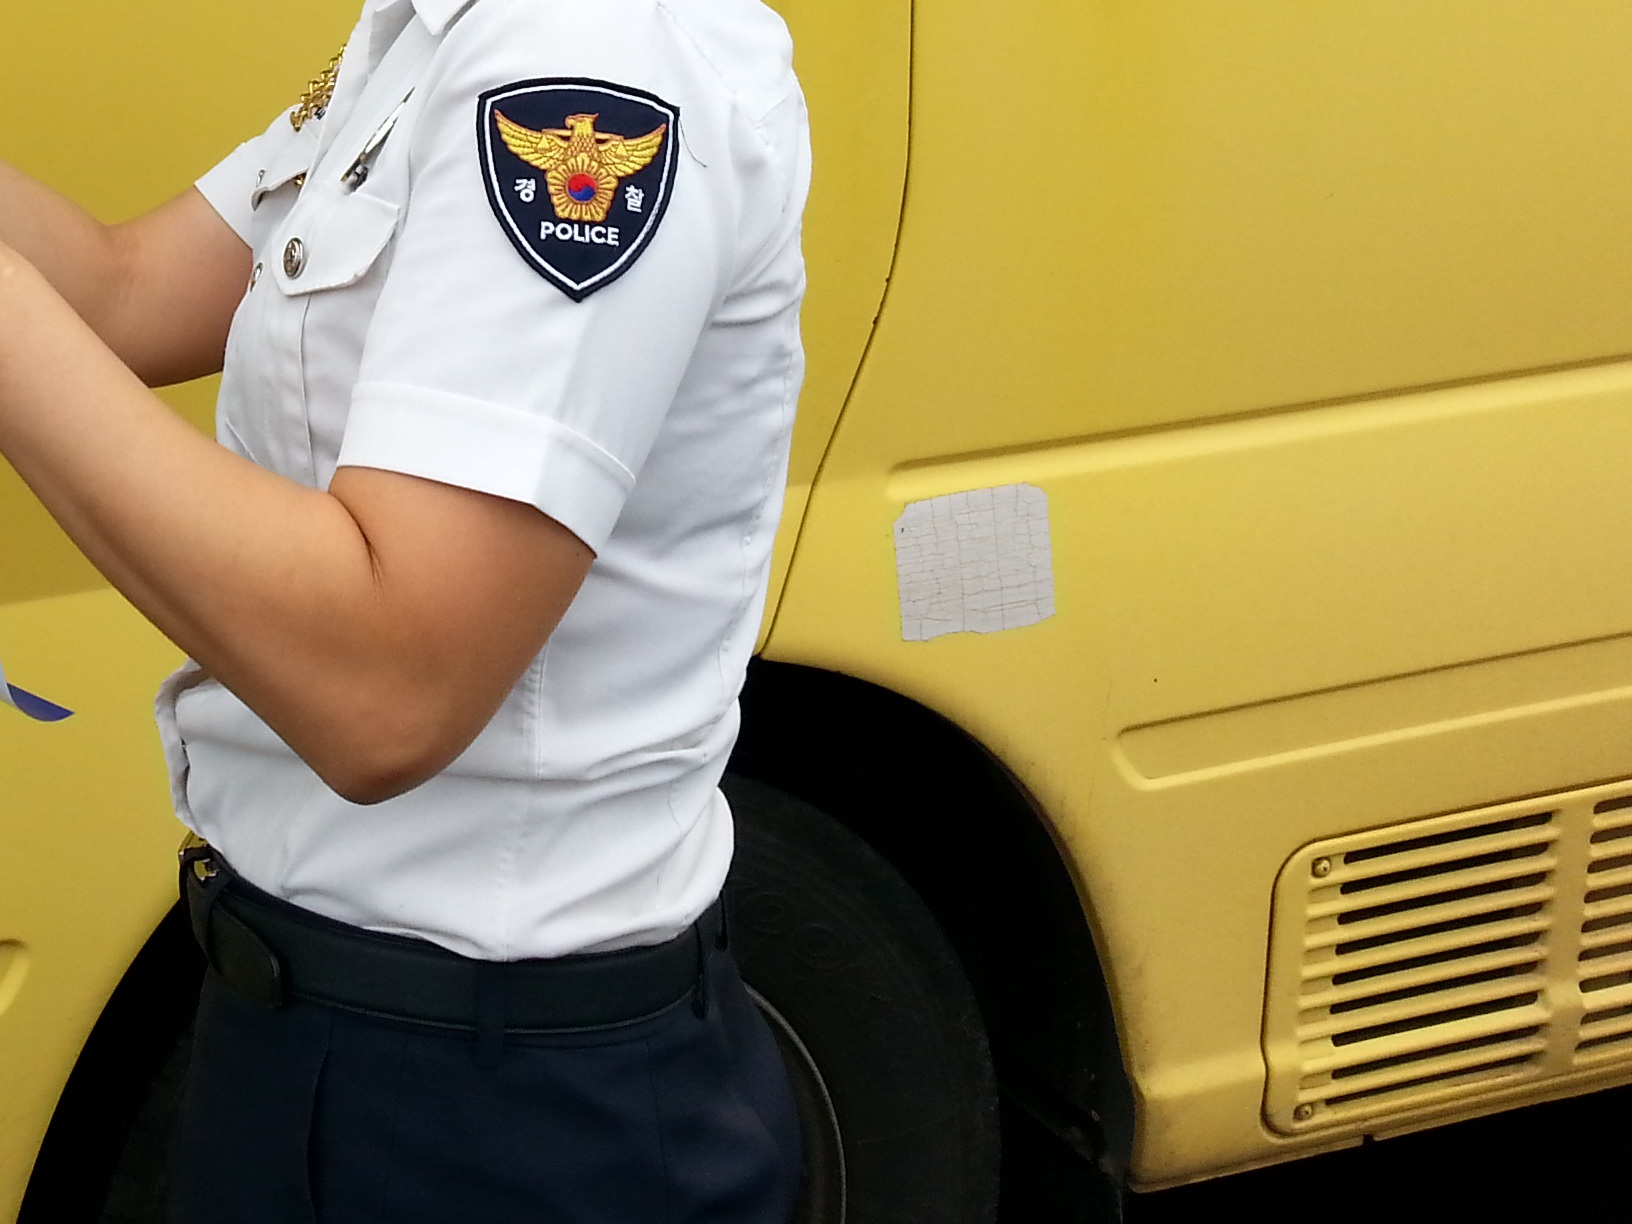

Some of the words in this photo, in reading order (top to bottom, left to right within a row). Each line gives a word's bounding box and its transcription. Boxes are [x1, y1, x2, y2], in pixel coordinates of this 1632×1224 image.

[515, 178, 535, 202] 경
[625, 185, 644, 212] 찰
[540, 221, 619, 246] POLICE
